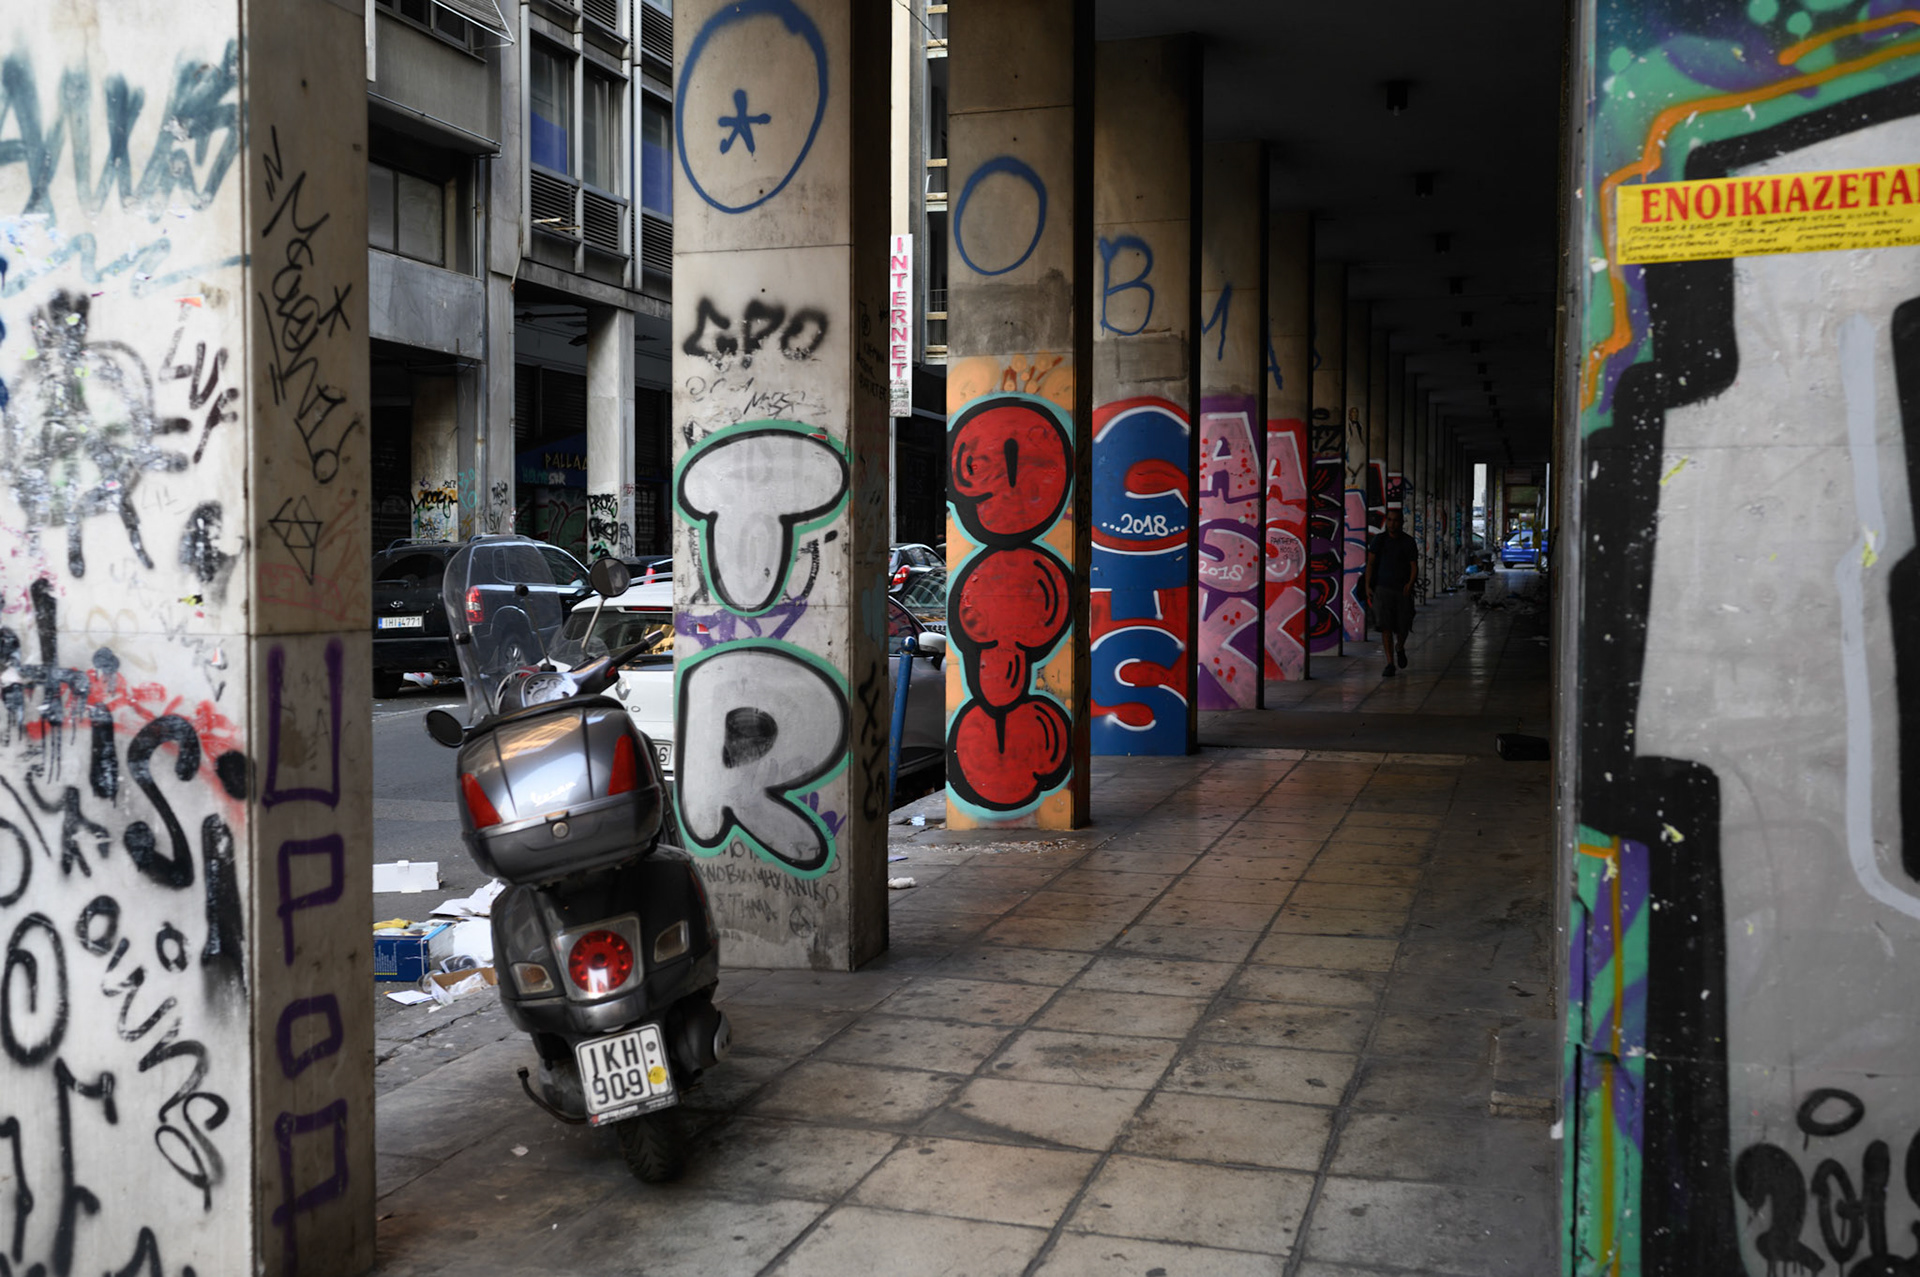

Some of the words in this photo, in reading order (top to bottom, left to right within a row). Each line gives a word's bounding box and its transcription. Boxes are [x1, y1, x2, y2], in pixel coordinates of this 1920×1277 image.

[891, 236, 909, 379] INTERNET
[1199, 560, 1244, 581] 2018
[592, 1069, 644, 1105] 909
